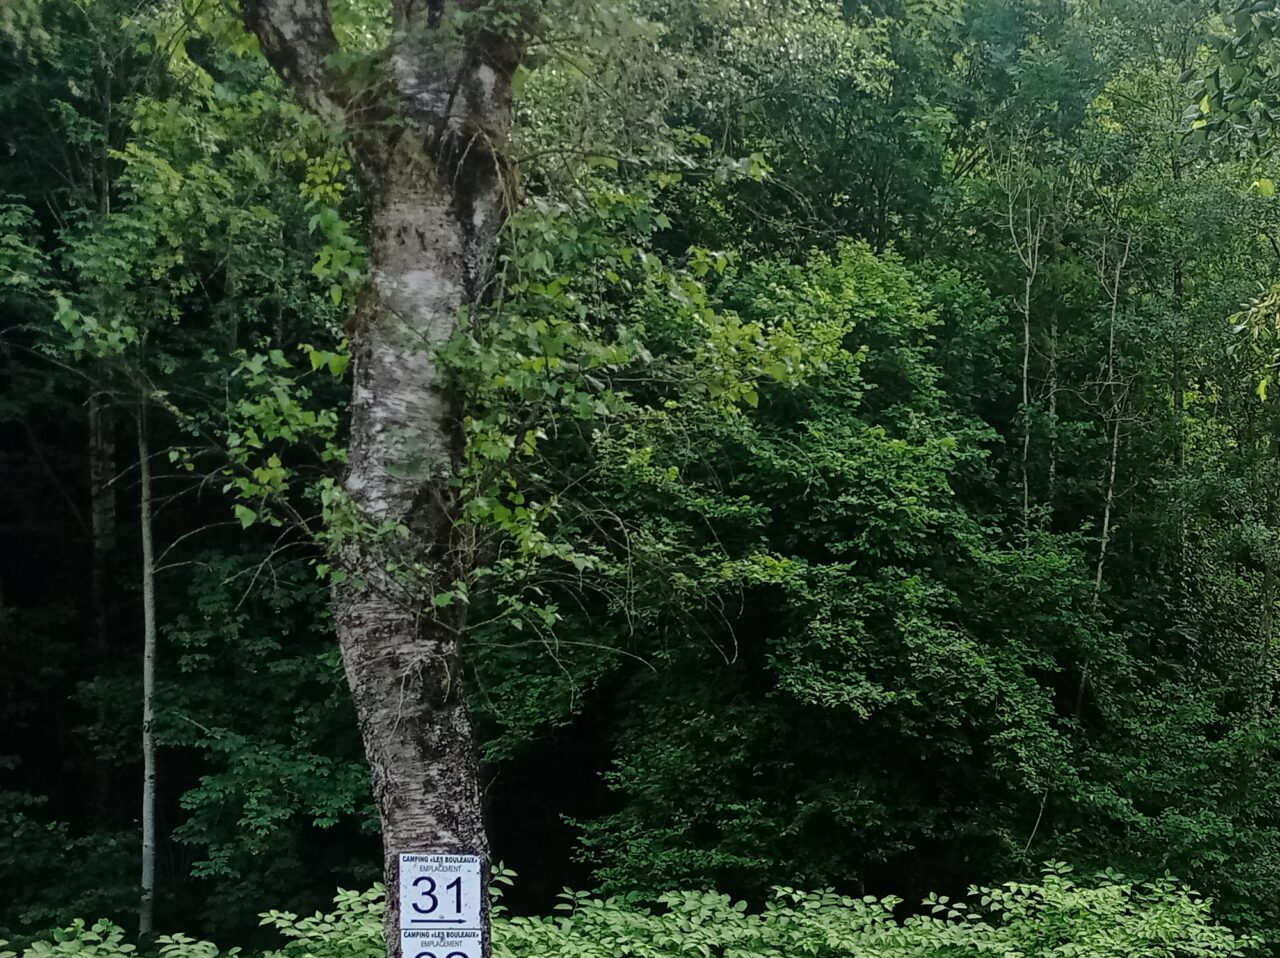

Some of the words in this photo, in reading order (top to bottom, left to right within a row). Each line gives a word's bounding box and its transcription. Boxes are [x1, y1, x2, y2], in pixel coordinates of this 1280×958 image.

[402, 855, 429, 863] CAMPING
[419, 865, 462, 873] EMPLACEMENT
[411, 876, 462, 914] 31
[420, 940, 463, 948] EMPLACEMENT
